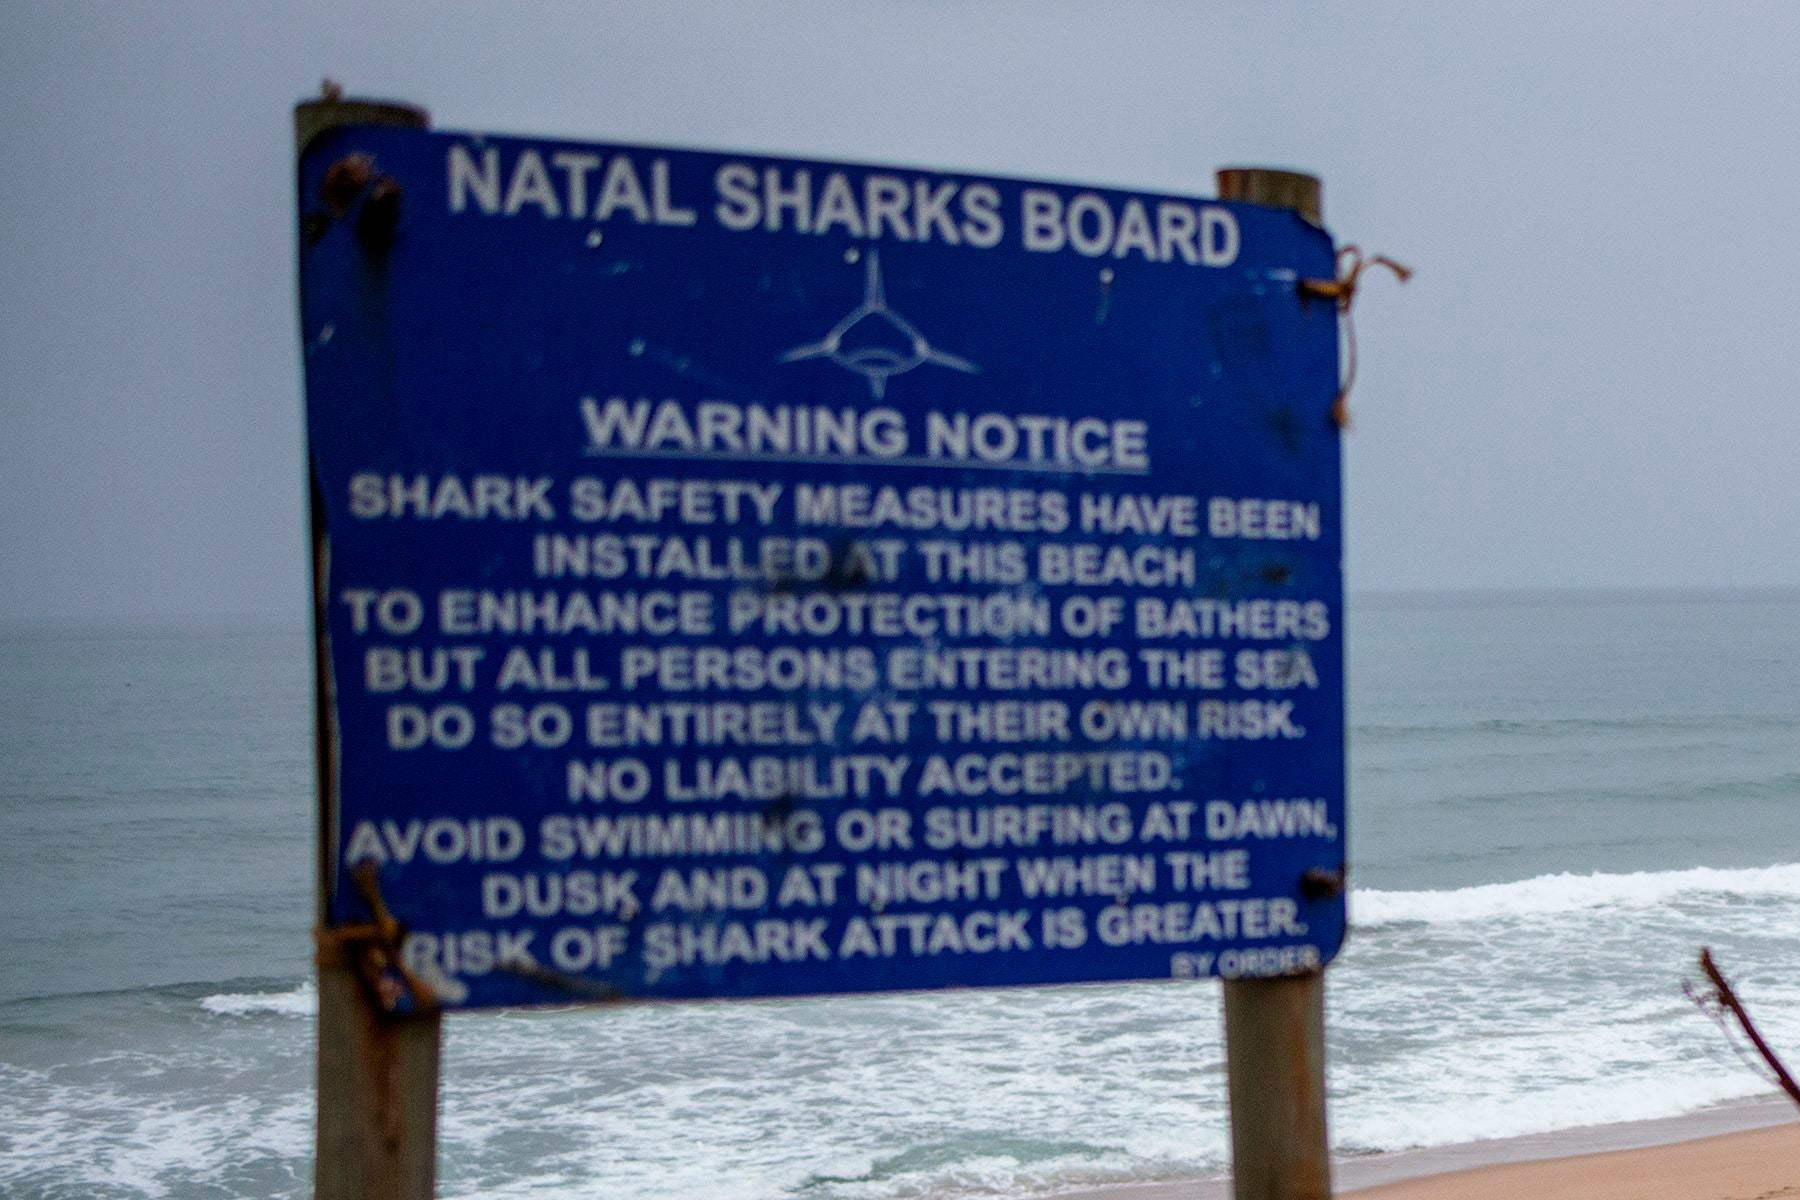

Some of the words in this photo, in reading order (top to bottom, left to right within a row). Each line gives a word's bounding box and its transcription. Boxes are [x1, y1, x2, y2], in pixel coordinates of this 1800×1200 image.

[446, 143, 697, 227] NATAL
[714, 162, 1005, 249] SHARKS
[1022, 188, 1241, 268] BOARD
[580, 396, 908, 457] WARNING
[926, 411, 1149, 467] NOTICE
[349, 472, 554, 521] SHARK
[569, 476, 782, 524] SAFETY
[795, 483, 1069, 533] MEASURES
[1081, 492, 1198, 537] HAVE
[1208, 497, 1320, 540] BEEN
[534, 533, 832, 581] INSTALLED
[841, 539, 908, 582] AT
[919, 541, 1025, 584] THIS
[1038, 545, 1195, 588] BEACH
[342, 590, 422, 634] TO
[439, 590, 713, 636] ENHANCE
[730, 592, 1050, 638] PROTECTION
[1061, 597, 1125, 639] OF
[1135, 599, 1329, 642] BATHERS
[364, 646, 485, 692] BUT
[498, 646, 608, 692] ALL
[621, 646, 878, 691] PERSONS
[889, 647, 1129, 691] ENTERING
[1139, 648, 1224, 690] THE
[1235, 648, 1318, 689] SEA
[387, 705, 475, 750] DO
[490, 704, 572, 749] SO
[586, 701, 845, 747] ENTIRELY
[853, 702, 917, 743] AT
[928, 701, 1070, 742] THEIR
[1079, 700, 1186, 741] OWN
[1199, 699, 1306, 740] RISK.
[566, 758, 651, 801] NO
[664, 755, 910, 800] LIABILITY
[918, 751, 1183, 797] ACCEPTED.
[345, 817, 525, 865] AVOID
[539, 811, 824, 861] SWIMMING
[836, 809, 912, 852] OR
[925, 805, 1133, 847] SURFING
[1138, 802, 1200, 842] AT
[1205, 799, 1337, 843] DAWN,
[482, 870, 640, 919] DUSK
[653, 868, 768, 912] AND
[777, 863, 843, 905] AT
[856, 857, 1007, 904] NIGHT
[1016, 852, 1156, 896] WHEN
[1164, 848, 1250, 891] THE
[401, 928, 538, 977] RISK
[550, 926, 628, 972] OF
[643, 918, 830, 967] SHARK
[839, 909, 1032, 960] ATTACK
[1042, 906, 1086, 948] IS
[1097, 897, 1308, 947] GREATER.
